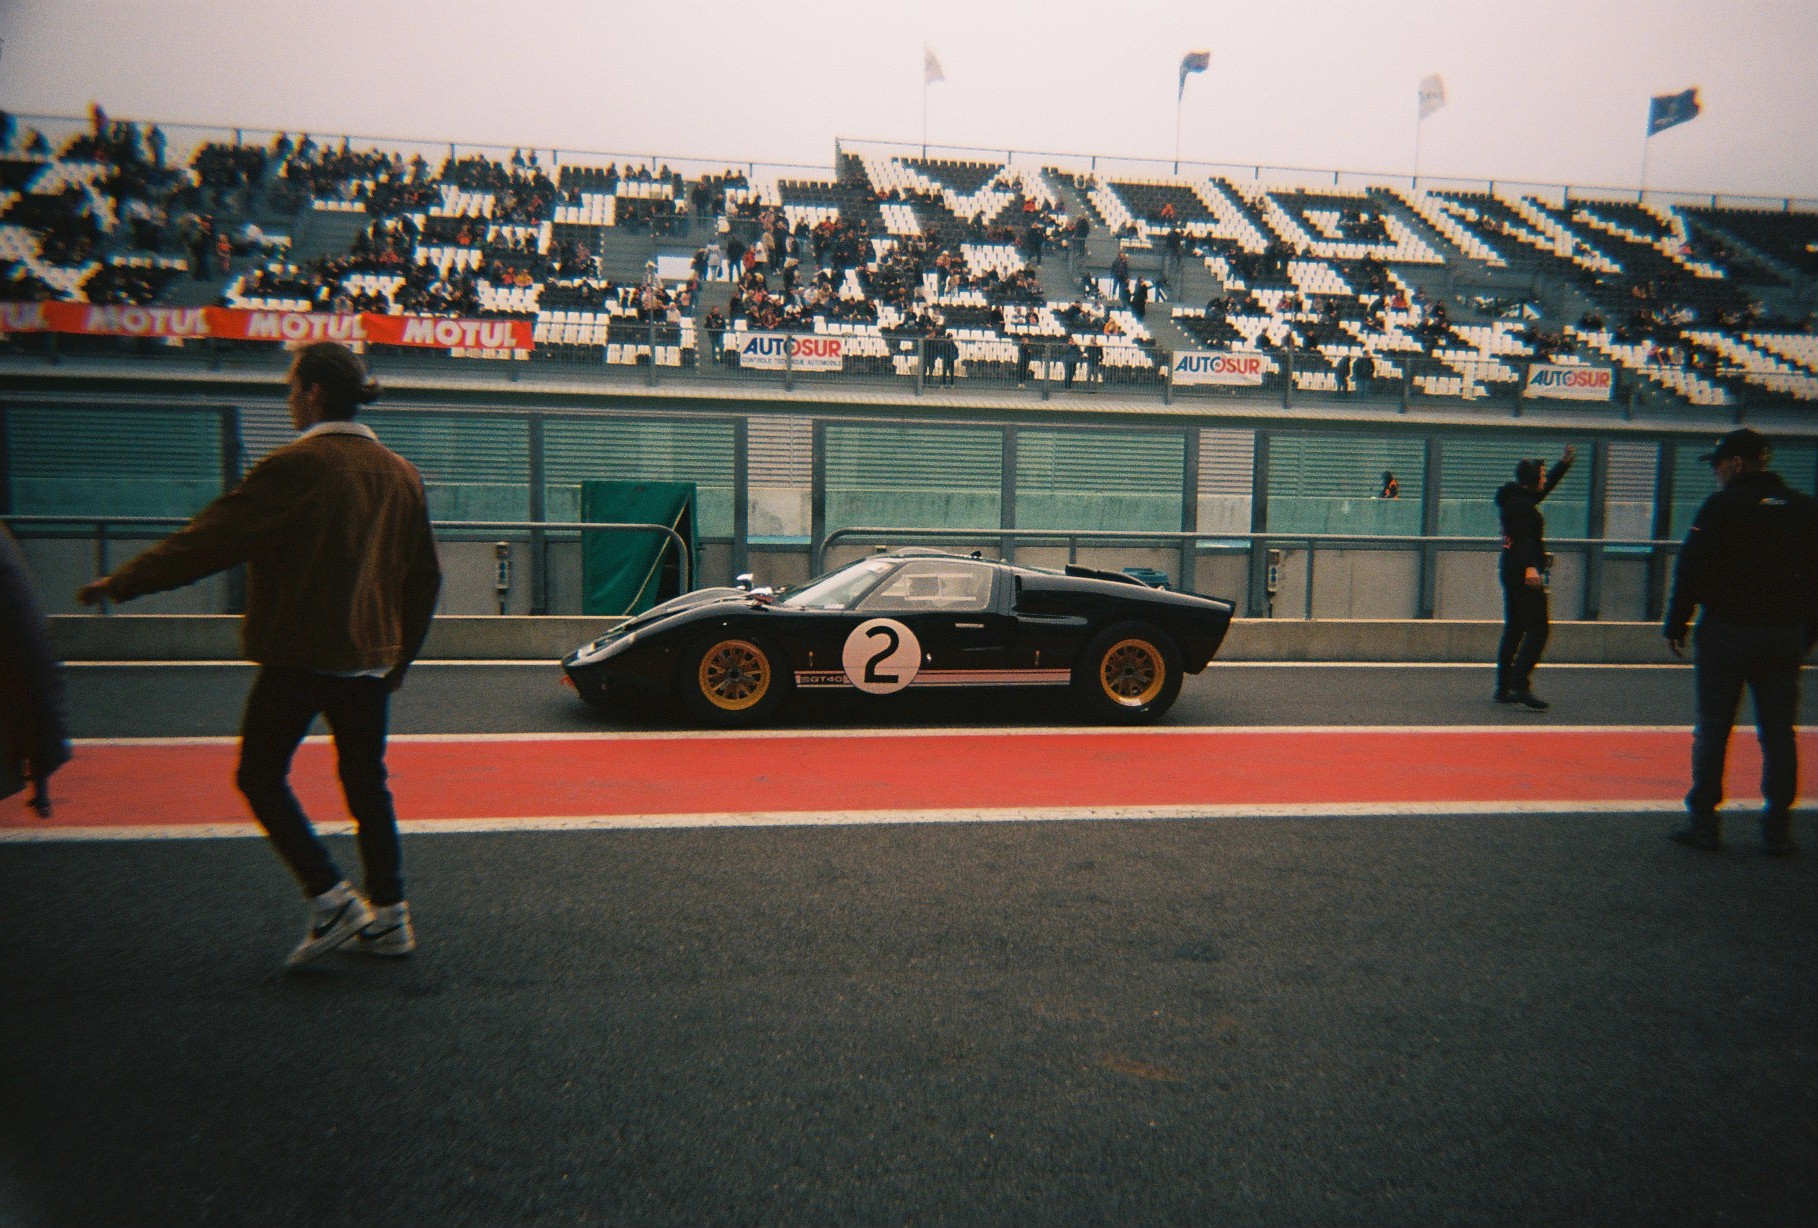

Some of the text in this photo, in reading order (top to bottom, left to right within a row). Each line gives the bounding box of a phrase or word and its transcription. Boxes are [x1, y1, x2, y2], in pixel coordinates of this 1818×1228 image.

[85, 305, 210, 334] MOTUL
[248, 312, 367, 340] MOTUL
[402, 318, 517, 347] MOTUL
[743, 337, 841, 358] AUTOSUR
[1174, 356, 1260, 374] AUTOSUR
[1529, 369, 1610, 388] AUTOSUR
[864, 625, 900, 684] 2
